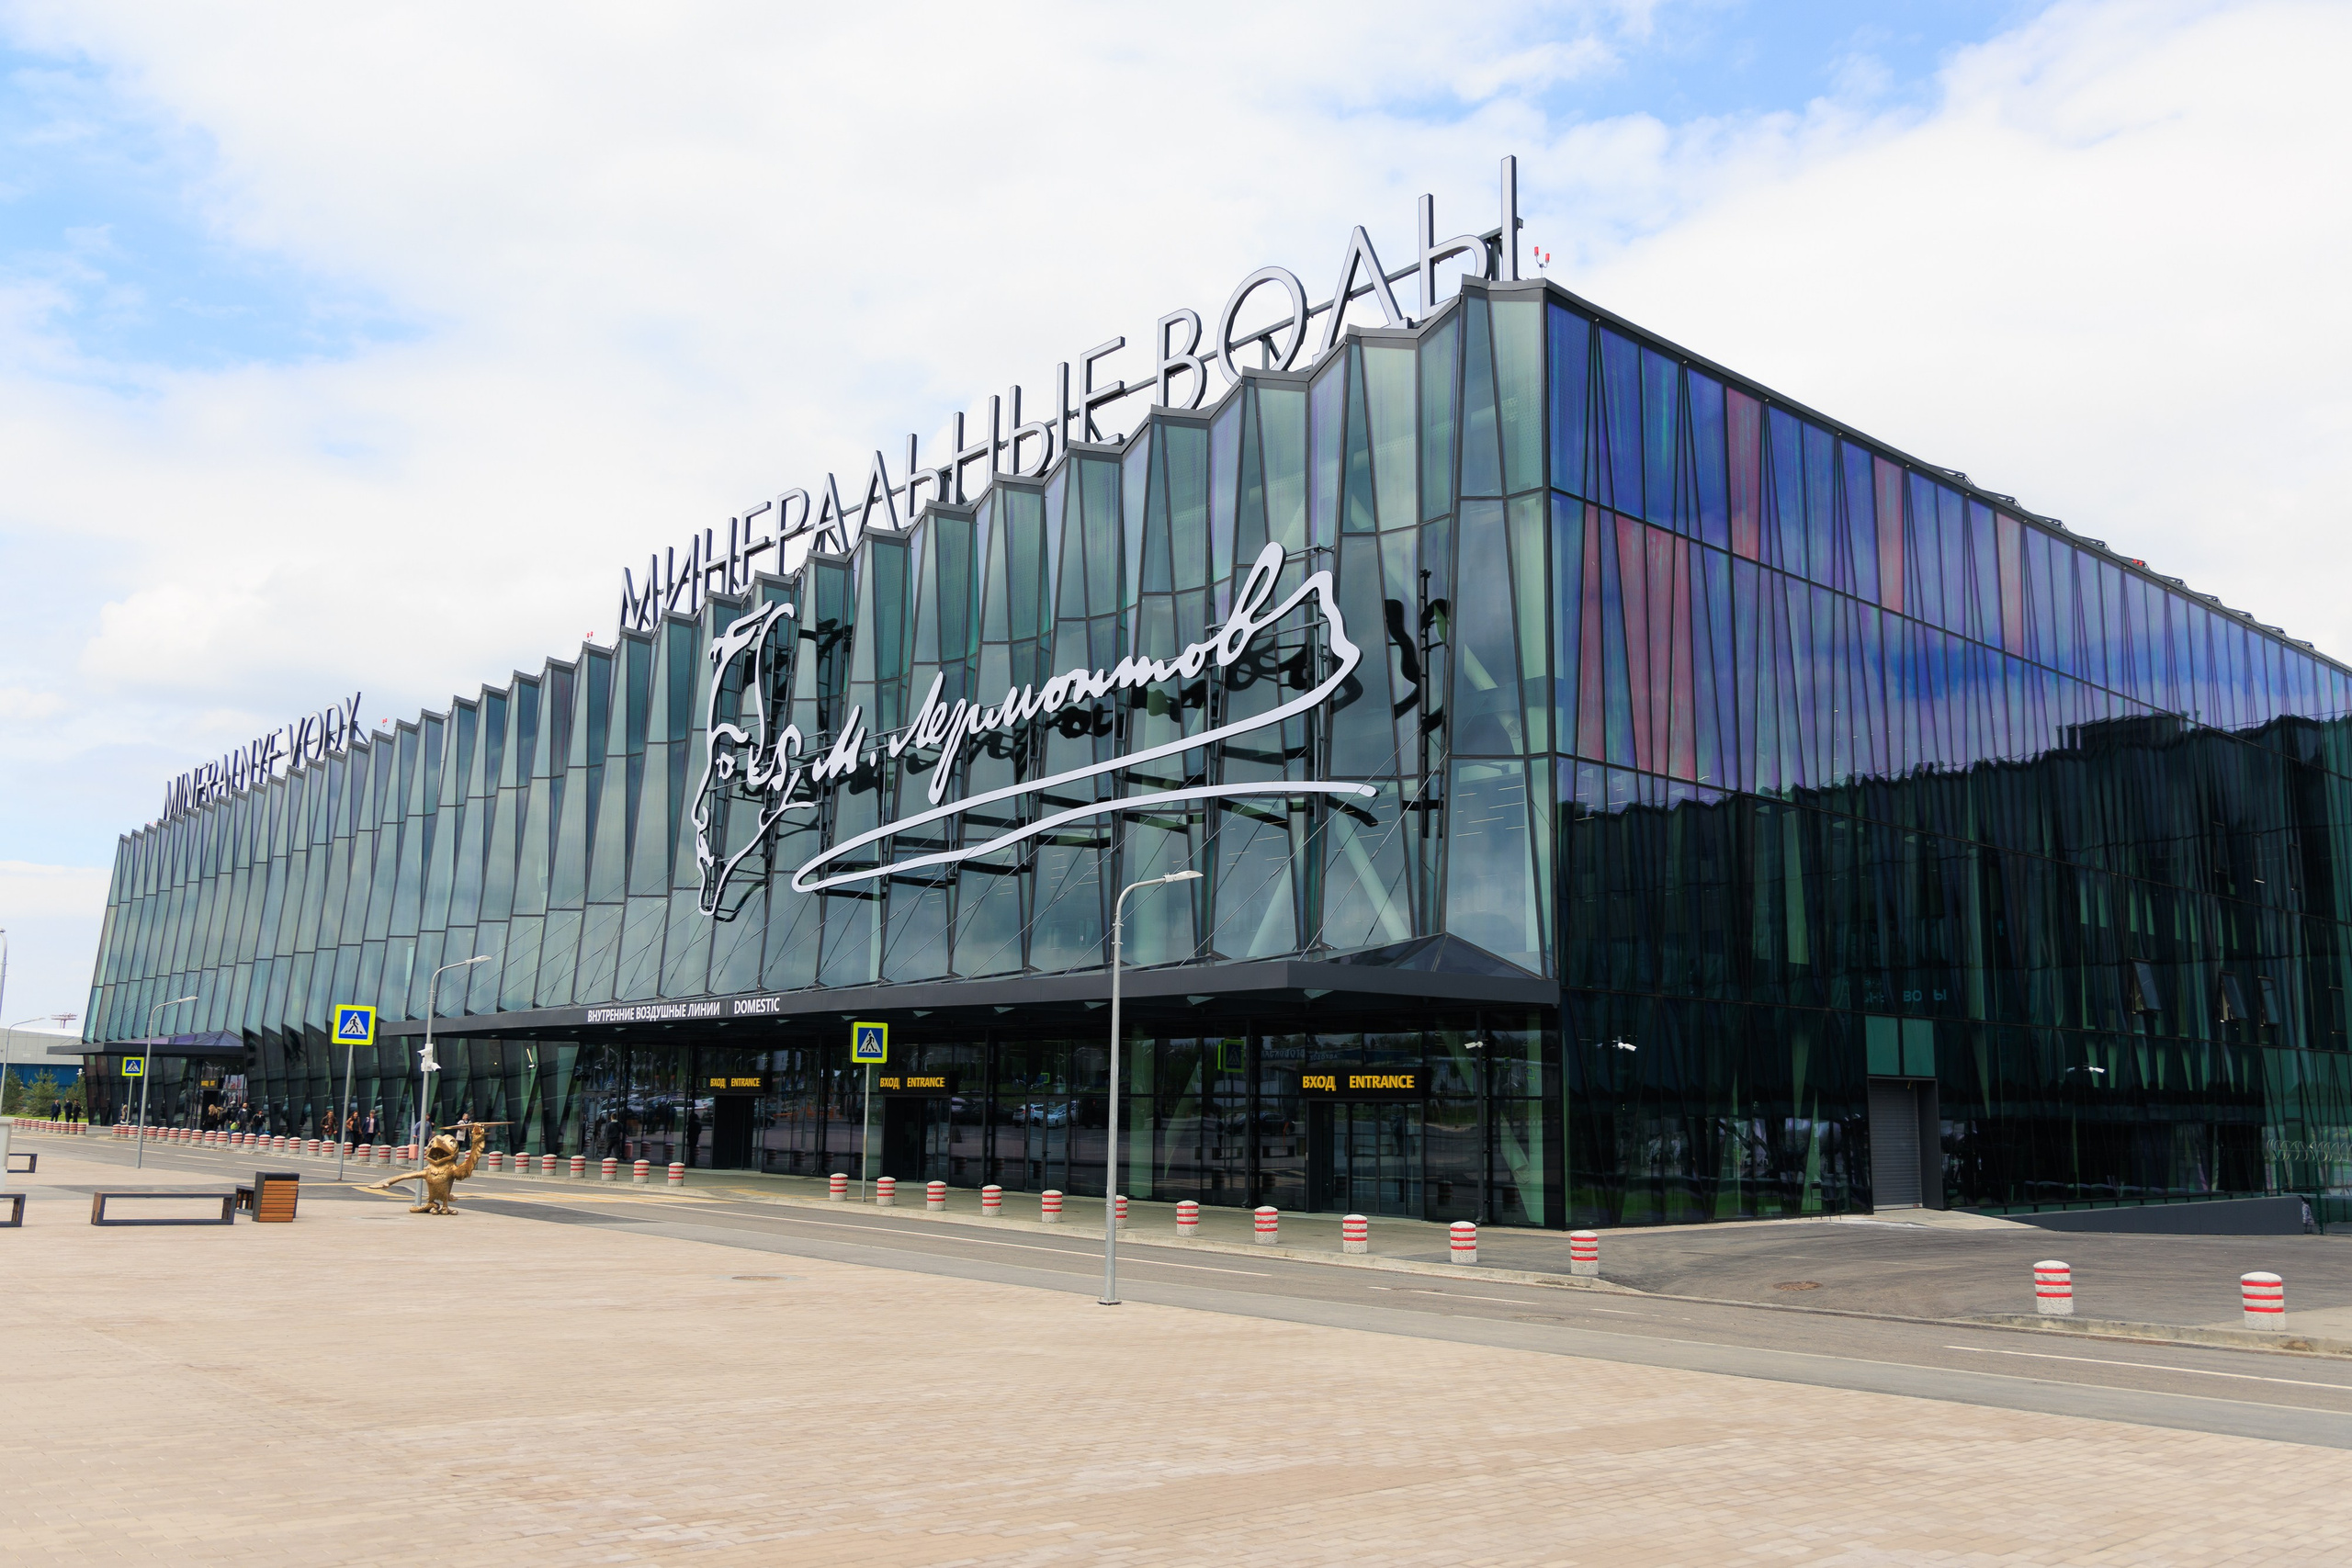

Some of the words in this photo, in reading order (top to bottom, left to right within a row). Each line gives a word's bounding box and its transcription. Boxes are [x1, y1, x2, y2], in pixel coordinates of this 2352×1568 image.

[618, 336, 1125, 631] МИНЕРАЛЬНЫЕ
[1157, 154, 1518, 410] ВОДЫ
[587, 1007, 635, 1022] ВНУТРЕННИЕ
[636, 1004, 686, 1021] ВОЗДУШНЫЕ
[687, 1002, 720, 1018] ЛИНИИ
[734, 998, 780, 1014] DOMESTIC
[710, 1077, 727, 1089] ВХОД
[730, 1077, 761, 1088] ENTRANCE
[879, 1077, 900, 1090] ВХОД
[907, 1077, 945, 1089] ENTRANCE
[1302, 1076, 1337, 1091] ВХОД
[1349, 1075, 1415, 1089] ENTRANCE
